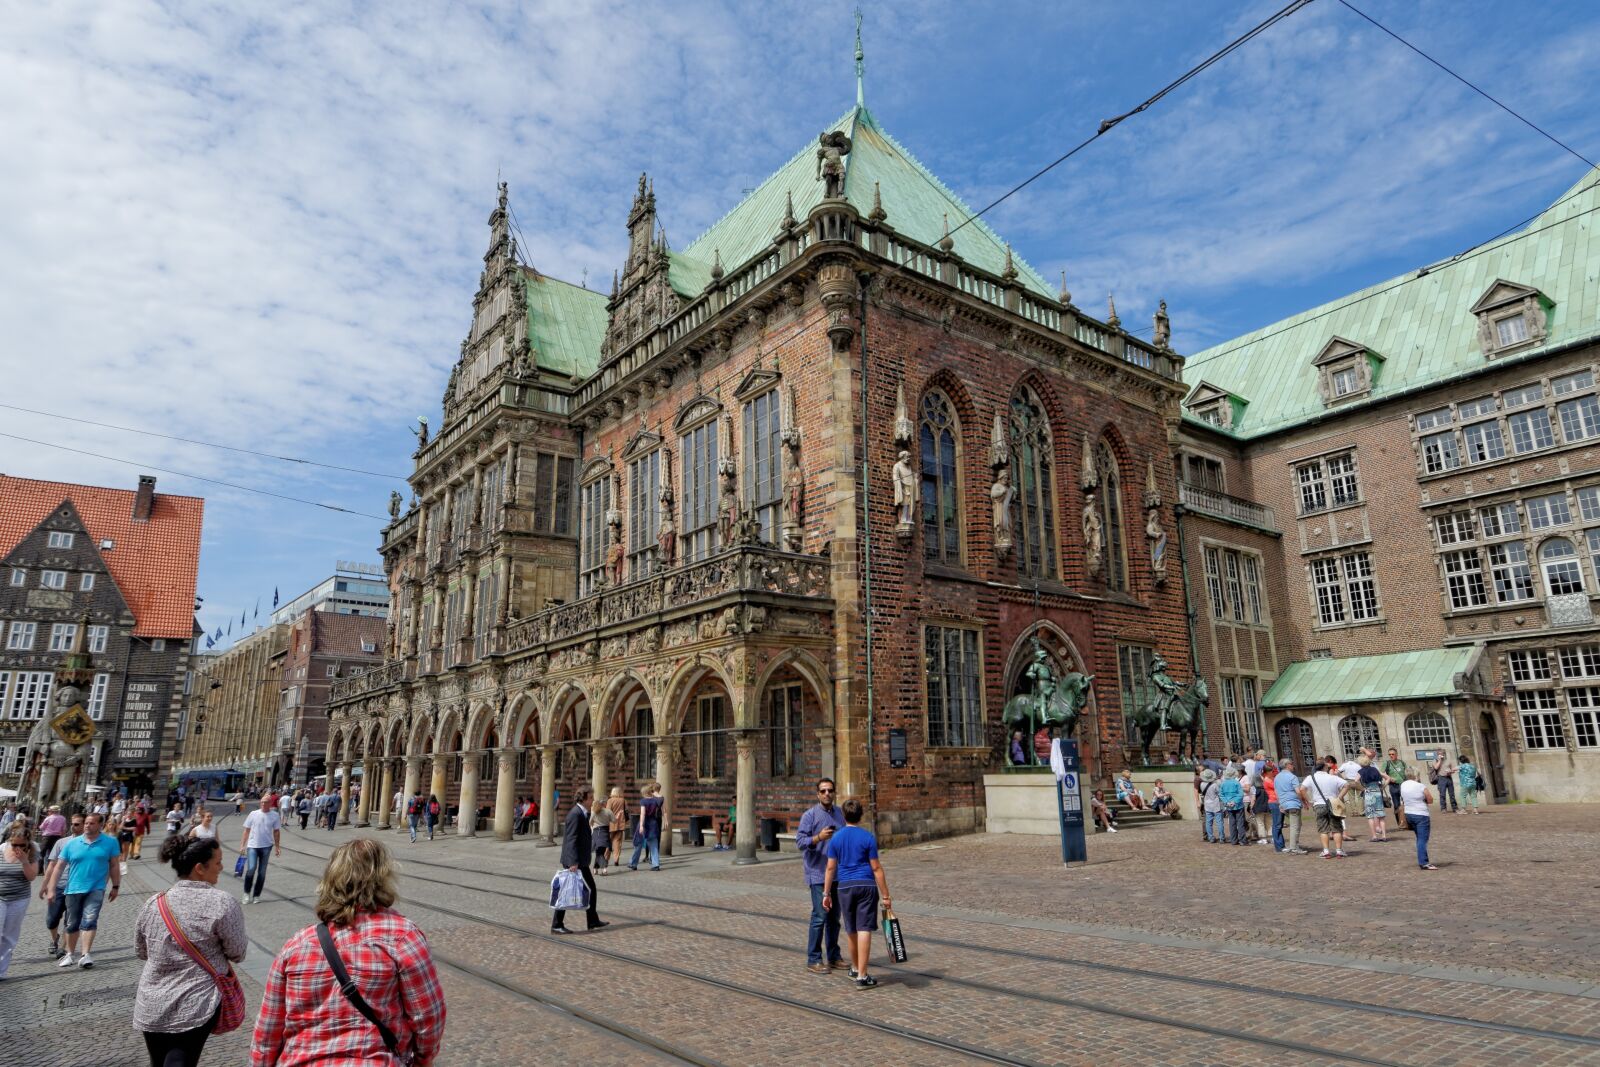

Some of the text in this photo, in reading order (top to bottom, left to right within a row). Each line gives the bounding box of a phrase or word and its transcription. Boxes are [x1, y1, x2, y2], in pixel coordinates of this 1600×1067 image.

[122, 721, 156, 729] SCHICKSAL
[120, 740, 154, 748] TRENNUNG
[892, 922, 903, 960] REMEMBER
